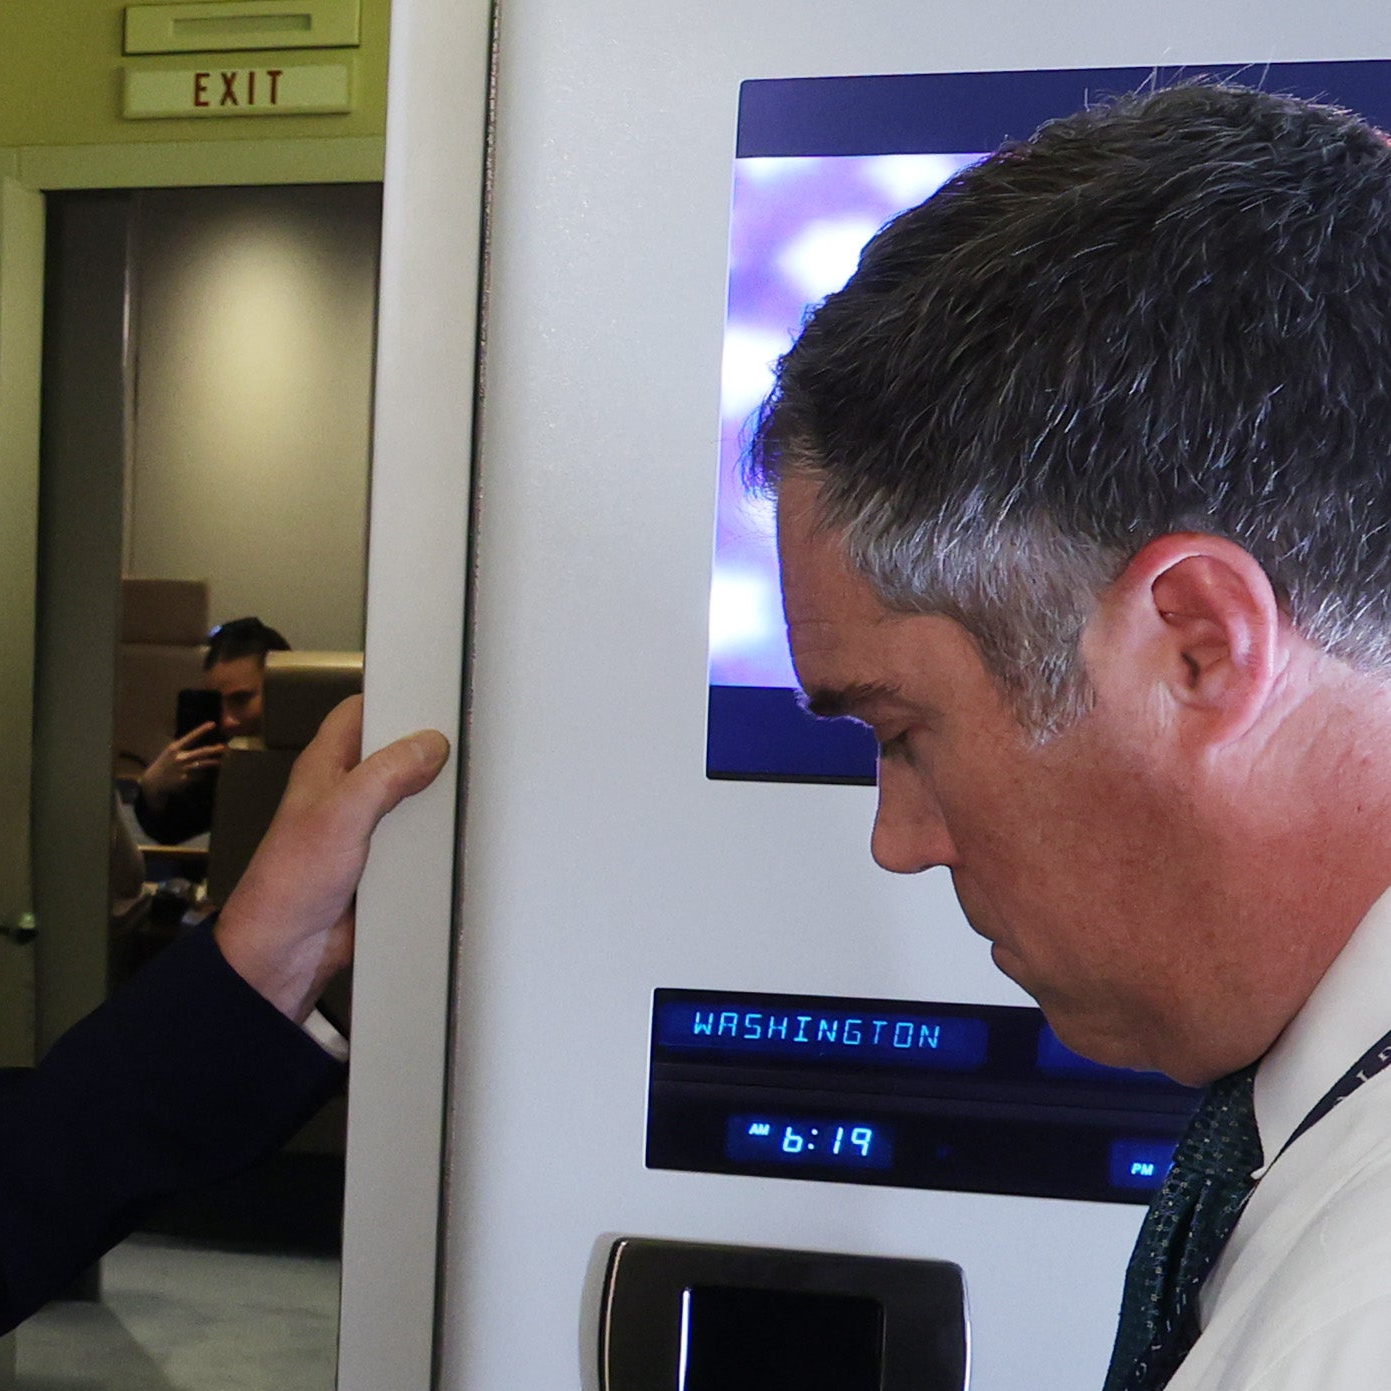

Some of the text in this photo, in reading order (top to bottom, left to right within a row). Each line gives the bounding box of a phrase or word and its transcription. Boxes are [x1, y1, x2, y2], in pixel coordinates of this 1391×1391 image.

[193, 69, 284, 107] EXIT
[693, 1011, 941, 1049] WASHINGTON
[748, 1122, 872, 1156] AM 6:19
[1130, 1162, 1155, 1176] PM
